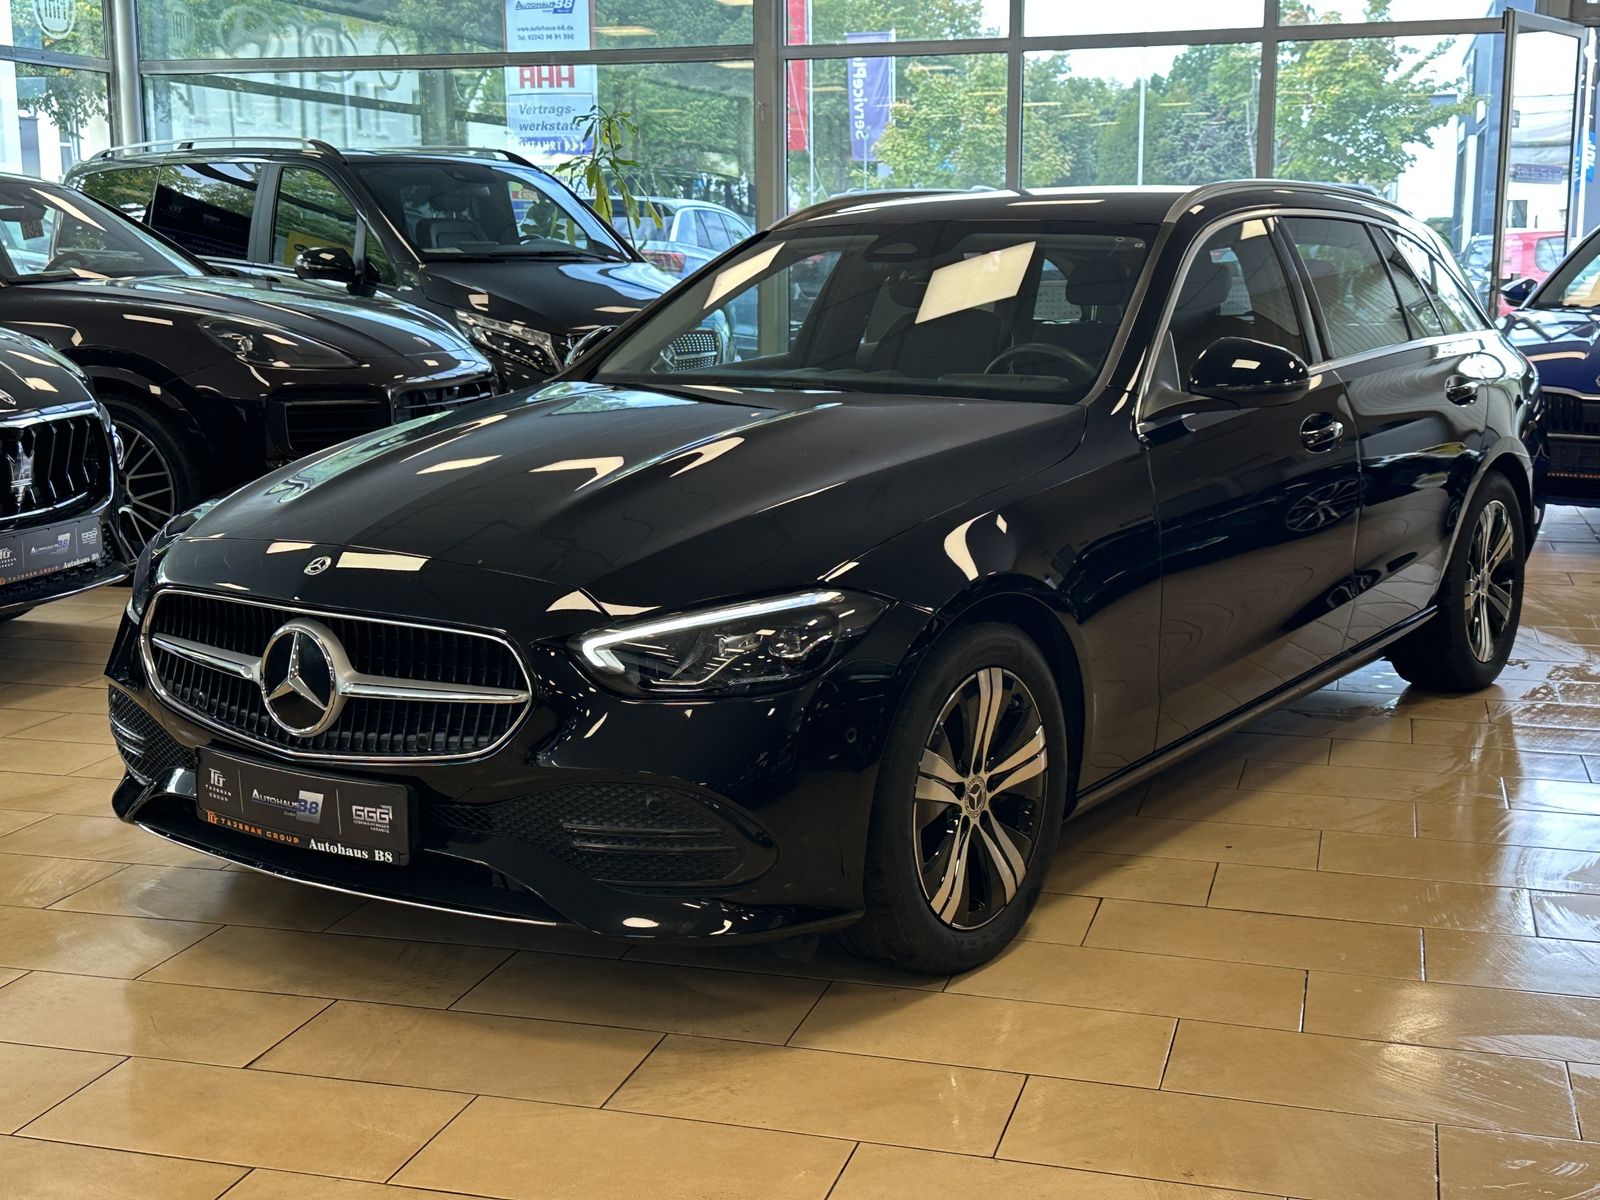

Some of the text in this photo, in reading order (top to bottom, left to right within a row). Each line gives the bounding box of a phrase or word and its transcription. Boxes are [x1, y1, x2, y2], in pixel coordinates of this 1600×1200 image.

[519, 104, 576, 117] Vertrags-
[266, 831, 300, 844] GROUP
[309, 838, 393, 863] Autohaus B8
